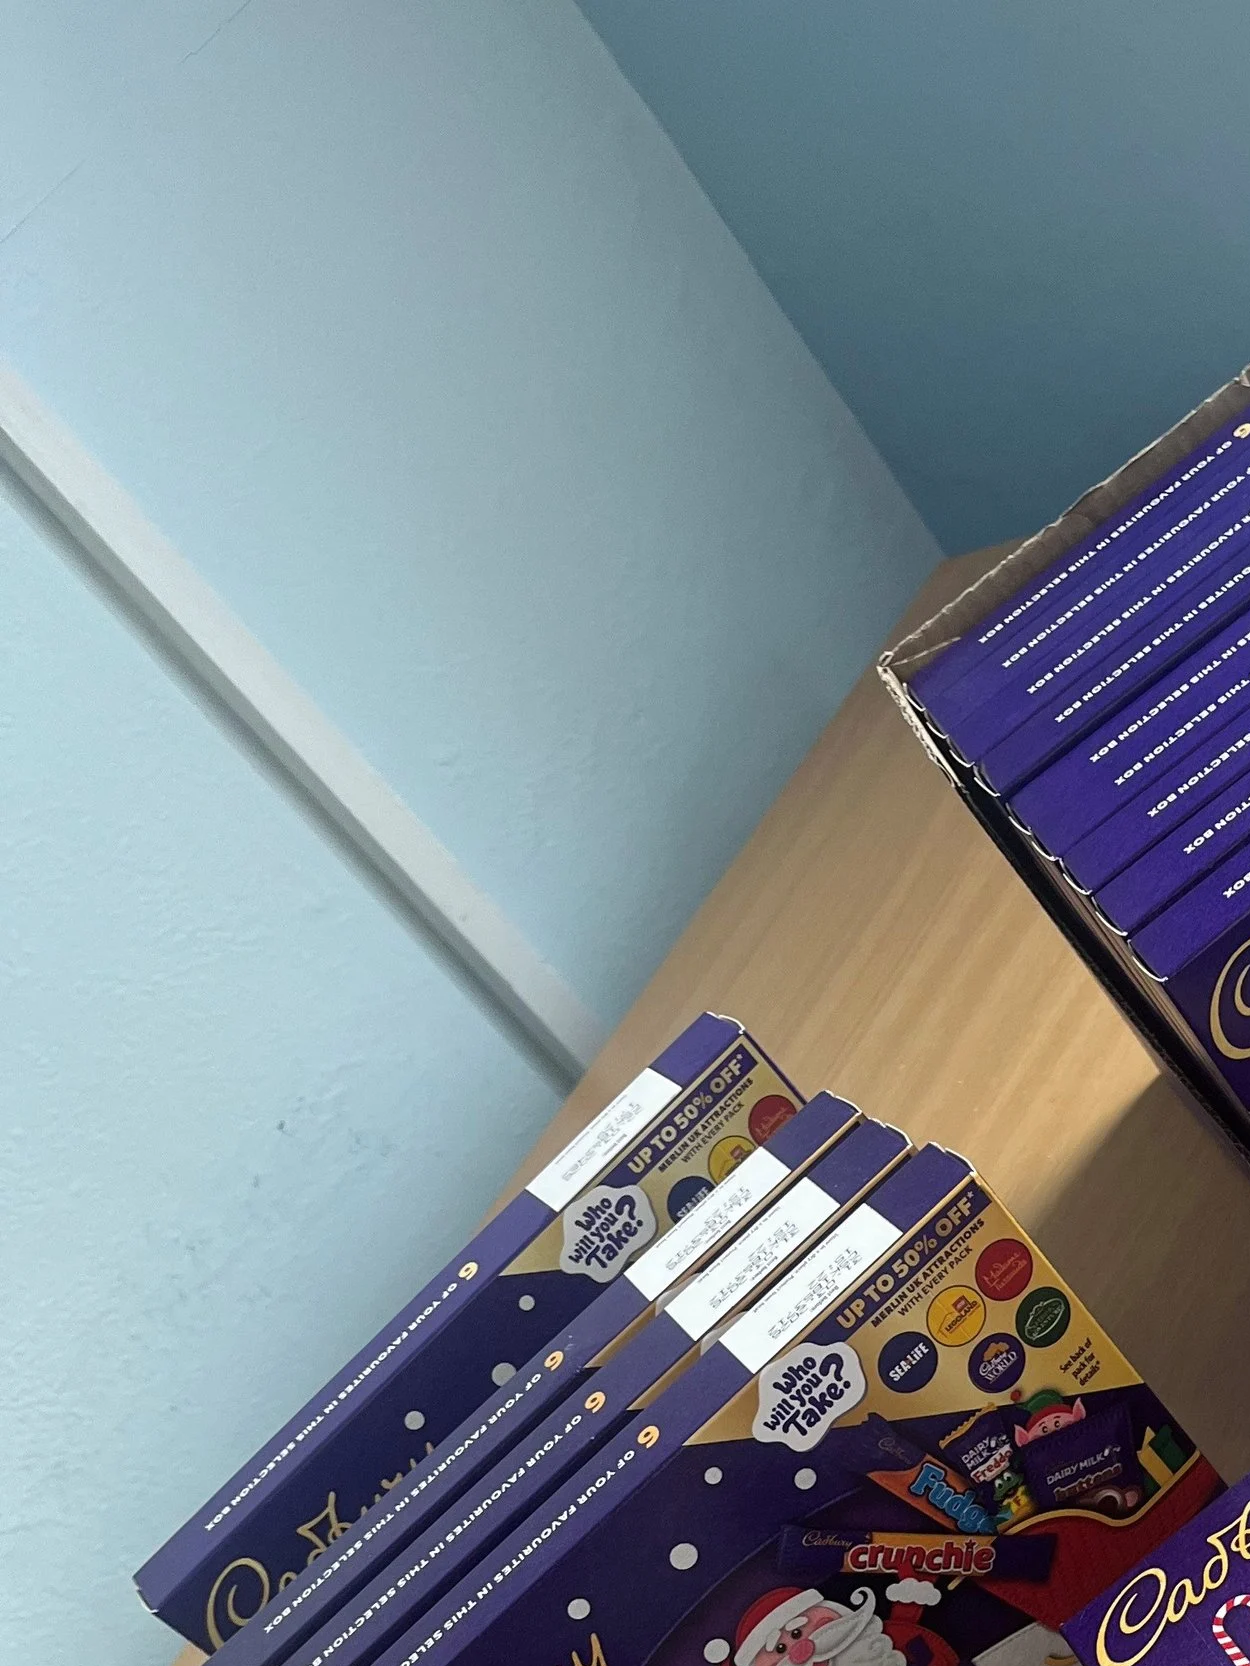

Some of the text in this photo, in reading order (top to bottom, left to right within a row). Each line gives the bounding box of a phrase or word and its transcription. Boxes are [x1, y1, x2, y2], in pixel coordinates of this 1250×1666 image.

[627, 1147, 651, 1173] UP
[650, 1126, 676, 1150] TO
[674, 1093, 712, 1129] 50%
[837, 1299, 865, 1328] UP
[863, 1274, 894, 1302] TO
[892, 1235, 937, 1278] 50%
[981, 1352, 1017, 1380] WORLD
[638, 1426, 659, 1444] 6
[618, 1451, 634, 1469] OF
[577, 1471, 615, 1504] YOUR
[494, 1505, 576, 1583] FAVOURITES
[848, 1540, 995, 1576] crunchie
[477, 1583, 492, 1599] IN
[444, 1601, 476, 1630] THIS
